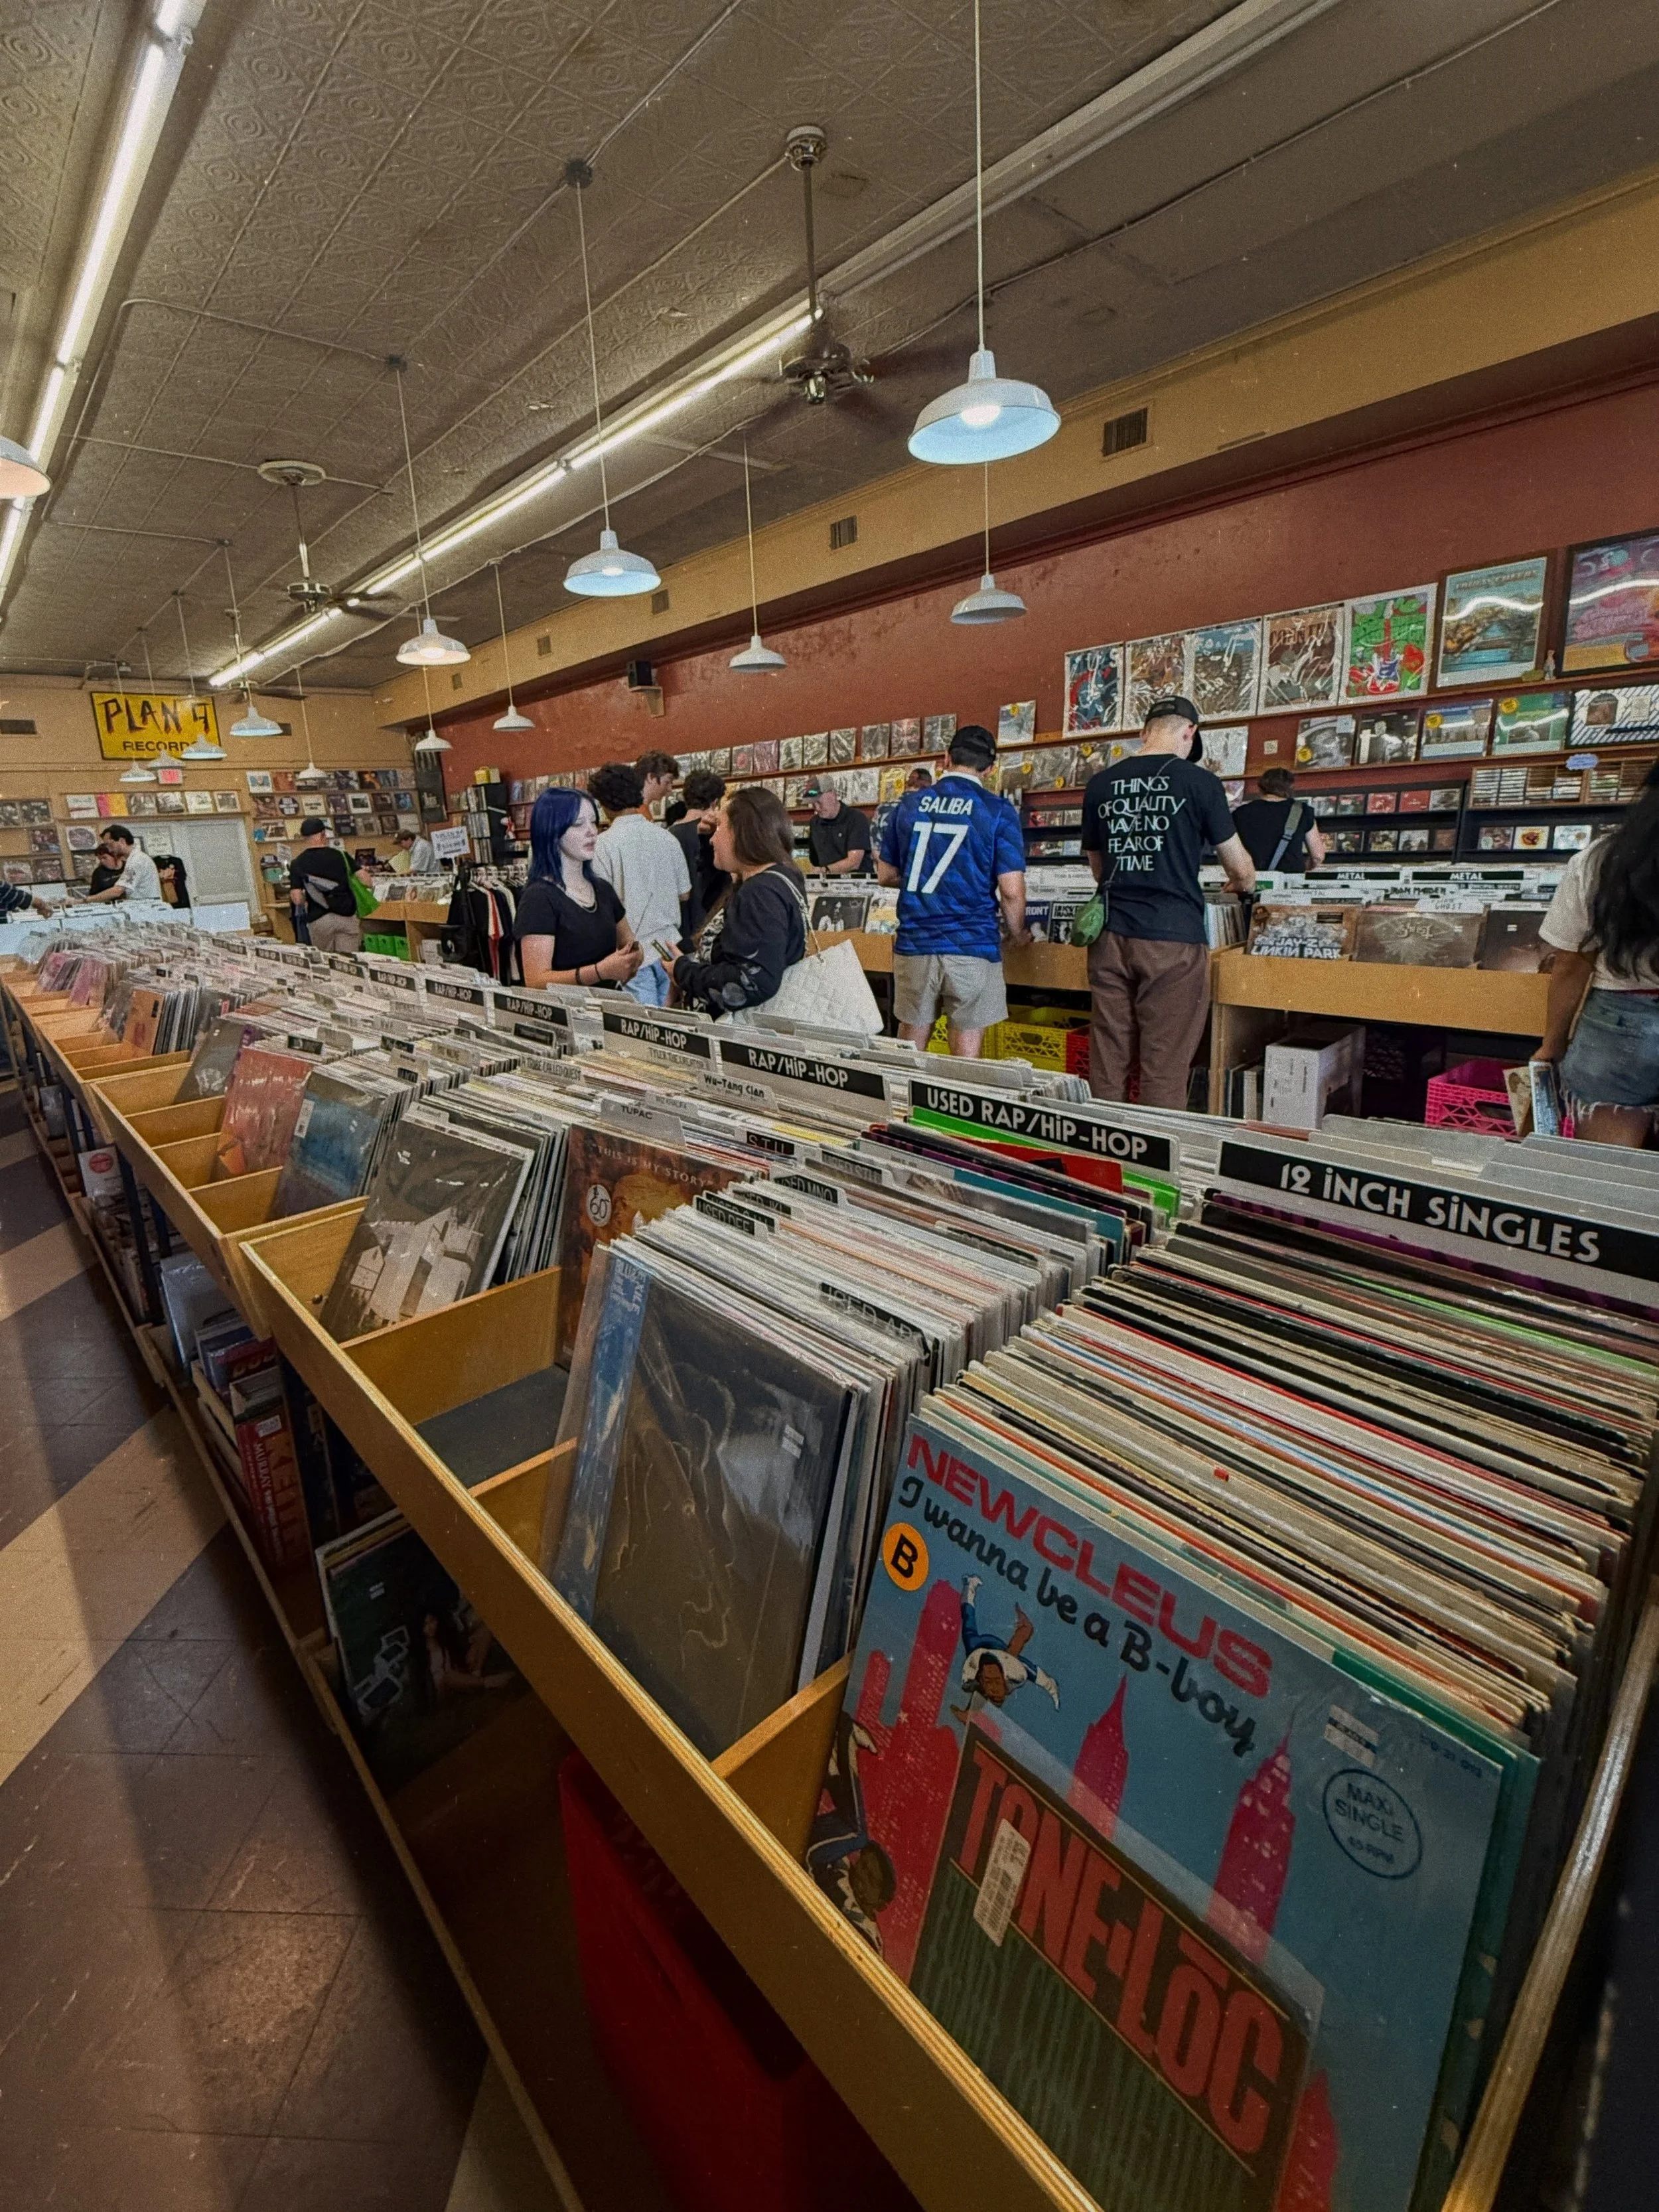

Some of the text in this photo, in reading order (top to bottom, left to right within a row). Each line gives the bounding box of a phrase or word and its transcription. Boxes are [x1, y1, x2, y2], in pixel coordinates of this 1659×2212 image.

[98, 698, 210, 734] PLAN 9
[123, 741, 197, 751] RECORD
[1110, 776, 1170, 795] THINGS
[919, 796, 974, 816] SALIBA
[1098, 796, 1187, 819] OF QUALITY
[1144, 815, 1169, 831] NO
[1108, 836, 1164, 853] FEAR OF
[906, 821, 968, 894] 17
[1116, 855, 1155, 871] TIME
[1025, 906, 1049, 916] RONT
[1304, 947, 1341, 959] PARK
[703, 1074, 743, 1094] Wu-Tang
[620, 1105, 652, 1120] TUPAC
[926, 1086, 974, 1118] USED
[643, 1160, 660, 1173] MY
[1280, 1162, 1311, 1195] 12
[807, 1181, 833, 1203] MNO
[698, 1201, 725, 1222] USED
[252, 1442, 272, 1489] MURRAY
[891, 1534, 919, 1579] B
[908, 1434, 1273, 1699] NEWCLEUS
[924, 1494, 1029, 1591] wanna
[1037, 1567, 1077, 1625] be
[1084, 1611, 1110, 1648] a
[1121, 1619, 1256, 1758] B-boy
[1334, 1798, 1405, 1844] SINGLE
[1366, 1843, 1394, 1865] RPM
